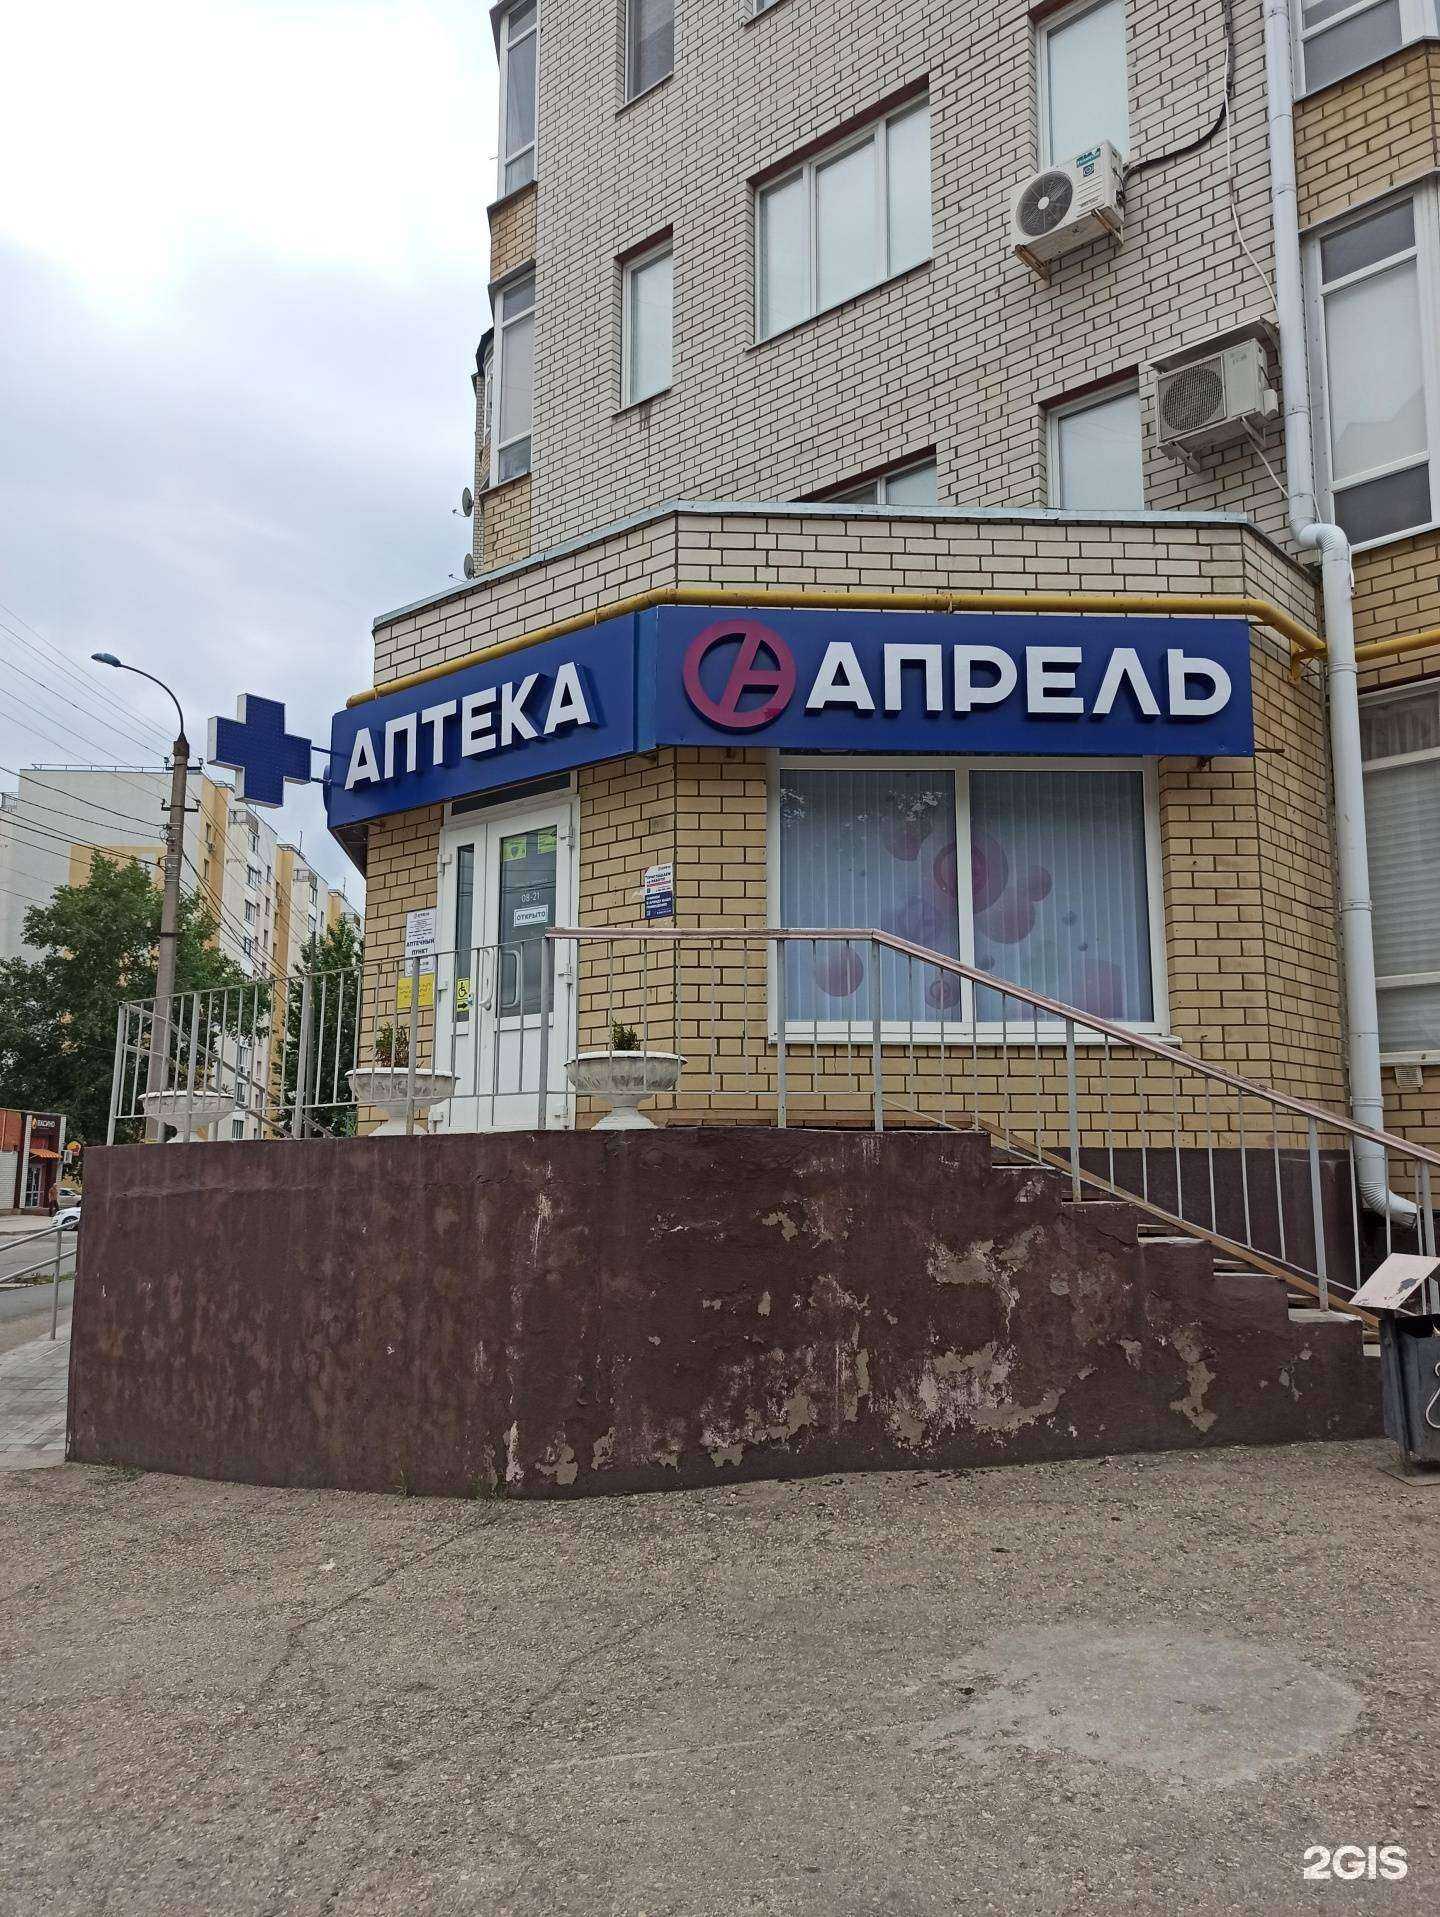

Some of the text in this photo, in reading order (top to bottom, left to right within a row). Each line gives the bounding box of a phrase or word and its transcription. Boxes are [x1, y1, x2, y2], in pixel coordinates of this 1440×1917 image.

[805, 641, 1232, 716] АПРЕЛЬ
[344, 661, 592, 791] АПТЕКА
[516, 911, 545, 921] ОТКРЫТО
[406, 938, 435, 947] АПТЕЧНЫЙ
[411, 948, 429, 956] ПУНКТ
